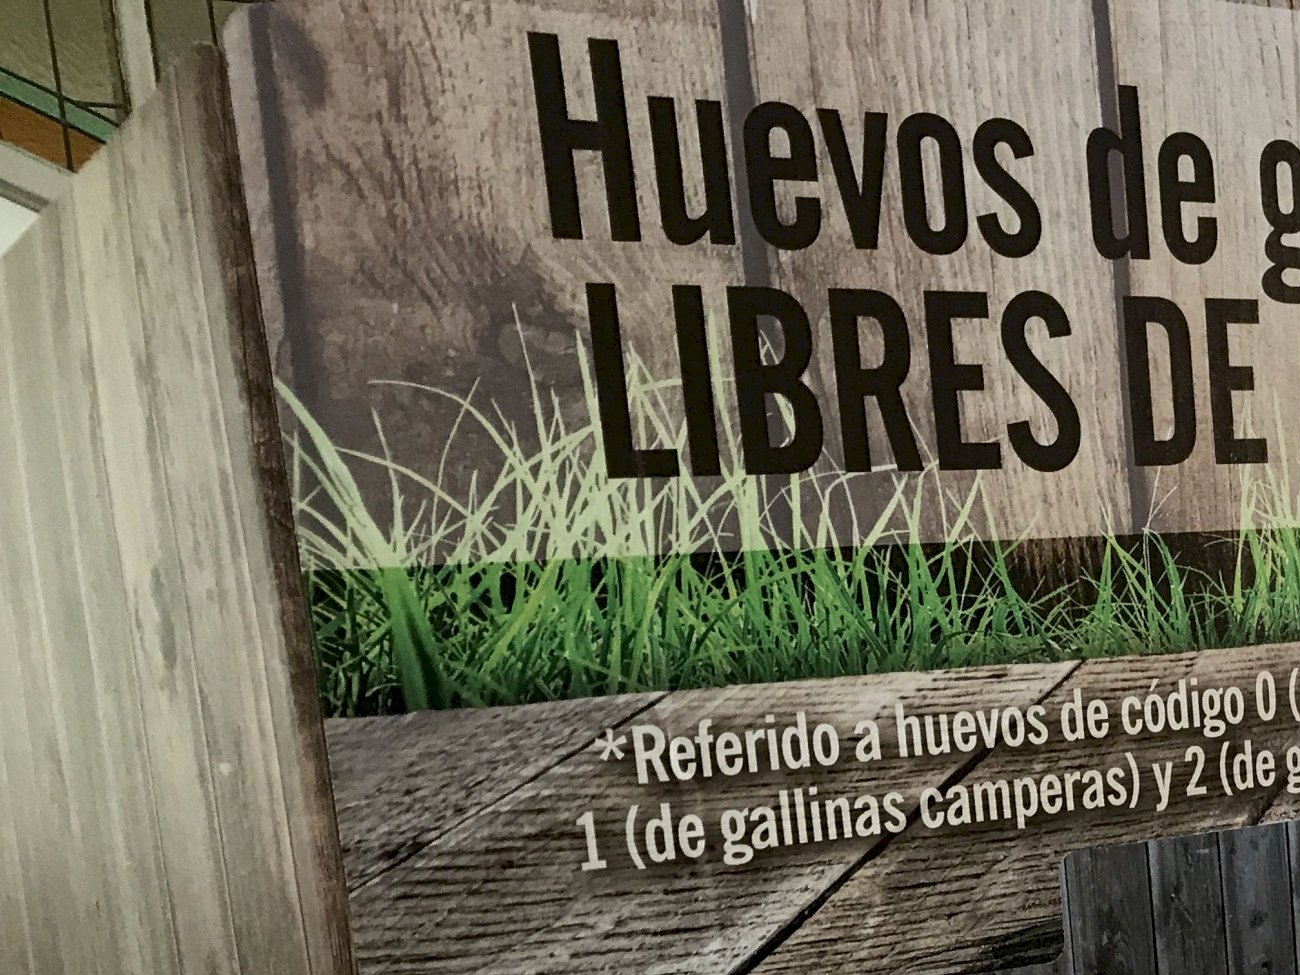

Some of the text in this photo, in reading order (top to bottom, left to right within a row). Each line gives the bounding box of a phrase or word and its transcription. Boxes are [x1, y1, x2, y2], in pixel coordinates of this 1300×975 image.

[527, 31, 1042, 258] Huevos
[1086, 85, 1218, 264] de
[585, 282, 1081, 478] LIBRES
[1122, 295, 1268, 466] DE
[853, 717, 882, 763] a
[895, 697, 1048, 759] huevos
[1060, 688, 1109, 741] de
[1122, 677, 1244, 739] código
[1255, 671, 1277, 721] 0
[576, 810, 607, 871] 1
[625, 802, 707, 870] (de
[721, 788, 907, 866] gallinas
[920, 751, 1140, 829] camperas)
[1154, 761, 1174, 811] y
[1185, 745, 1207, 797] 2
[1219, 741, 1277, 798] (de
